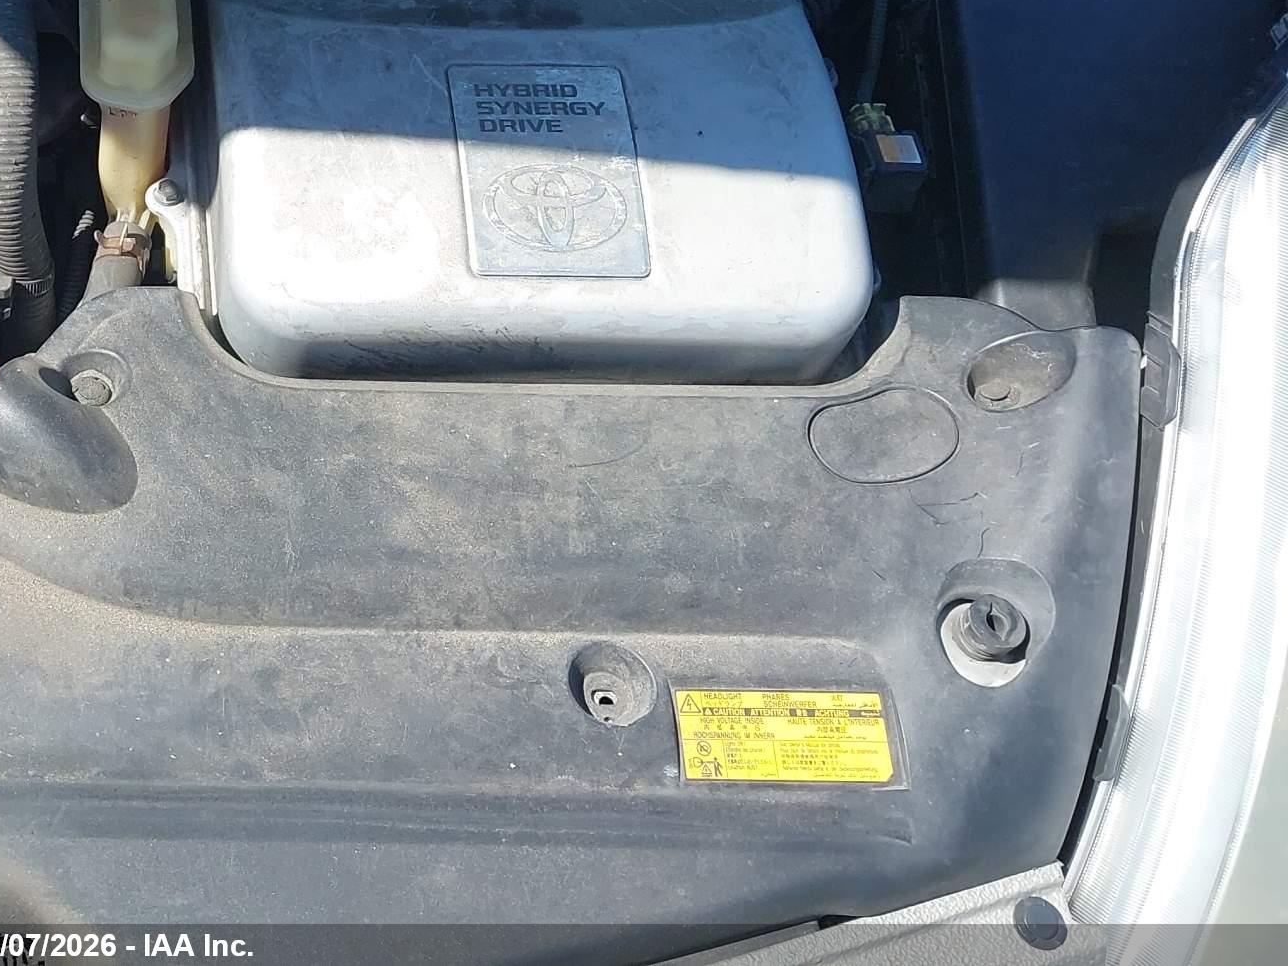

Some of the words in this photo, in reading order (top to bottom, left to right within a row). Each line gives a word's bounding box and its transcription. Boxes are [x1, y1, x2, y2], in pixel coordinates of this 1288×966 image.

[474, 84, 578, 98] HYBRID
[476, 102, 606, 115] SYNERGY
[480, 119, 564, 133] DRIVE
[762, 693, 790, 701] PHARES
[763, 700, 817, 708] SCHEINWERFER
[713, 708, 745, 716] CAUTION
[750, 708, 790, 716] ATTENTION
[815, 709, 850, 717] ACHTUNG
[716, 717, 743, 725] VOLTAGE
[745, 717, 765, 725] INSIDE
[787, 718, 808, 726] HAUTE
[809, 718, 834, 726] TENSION
